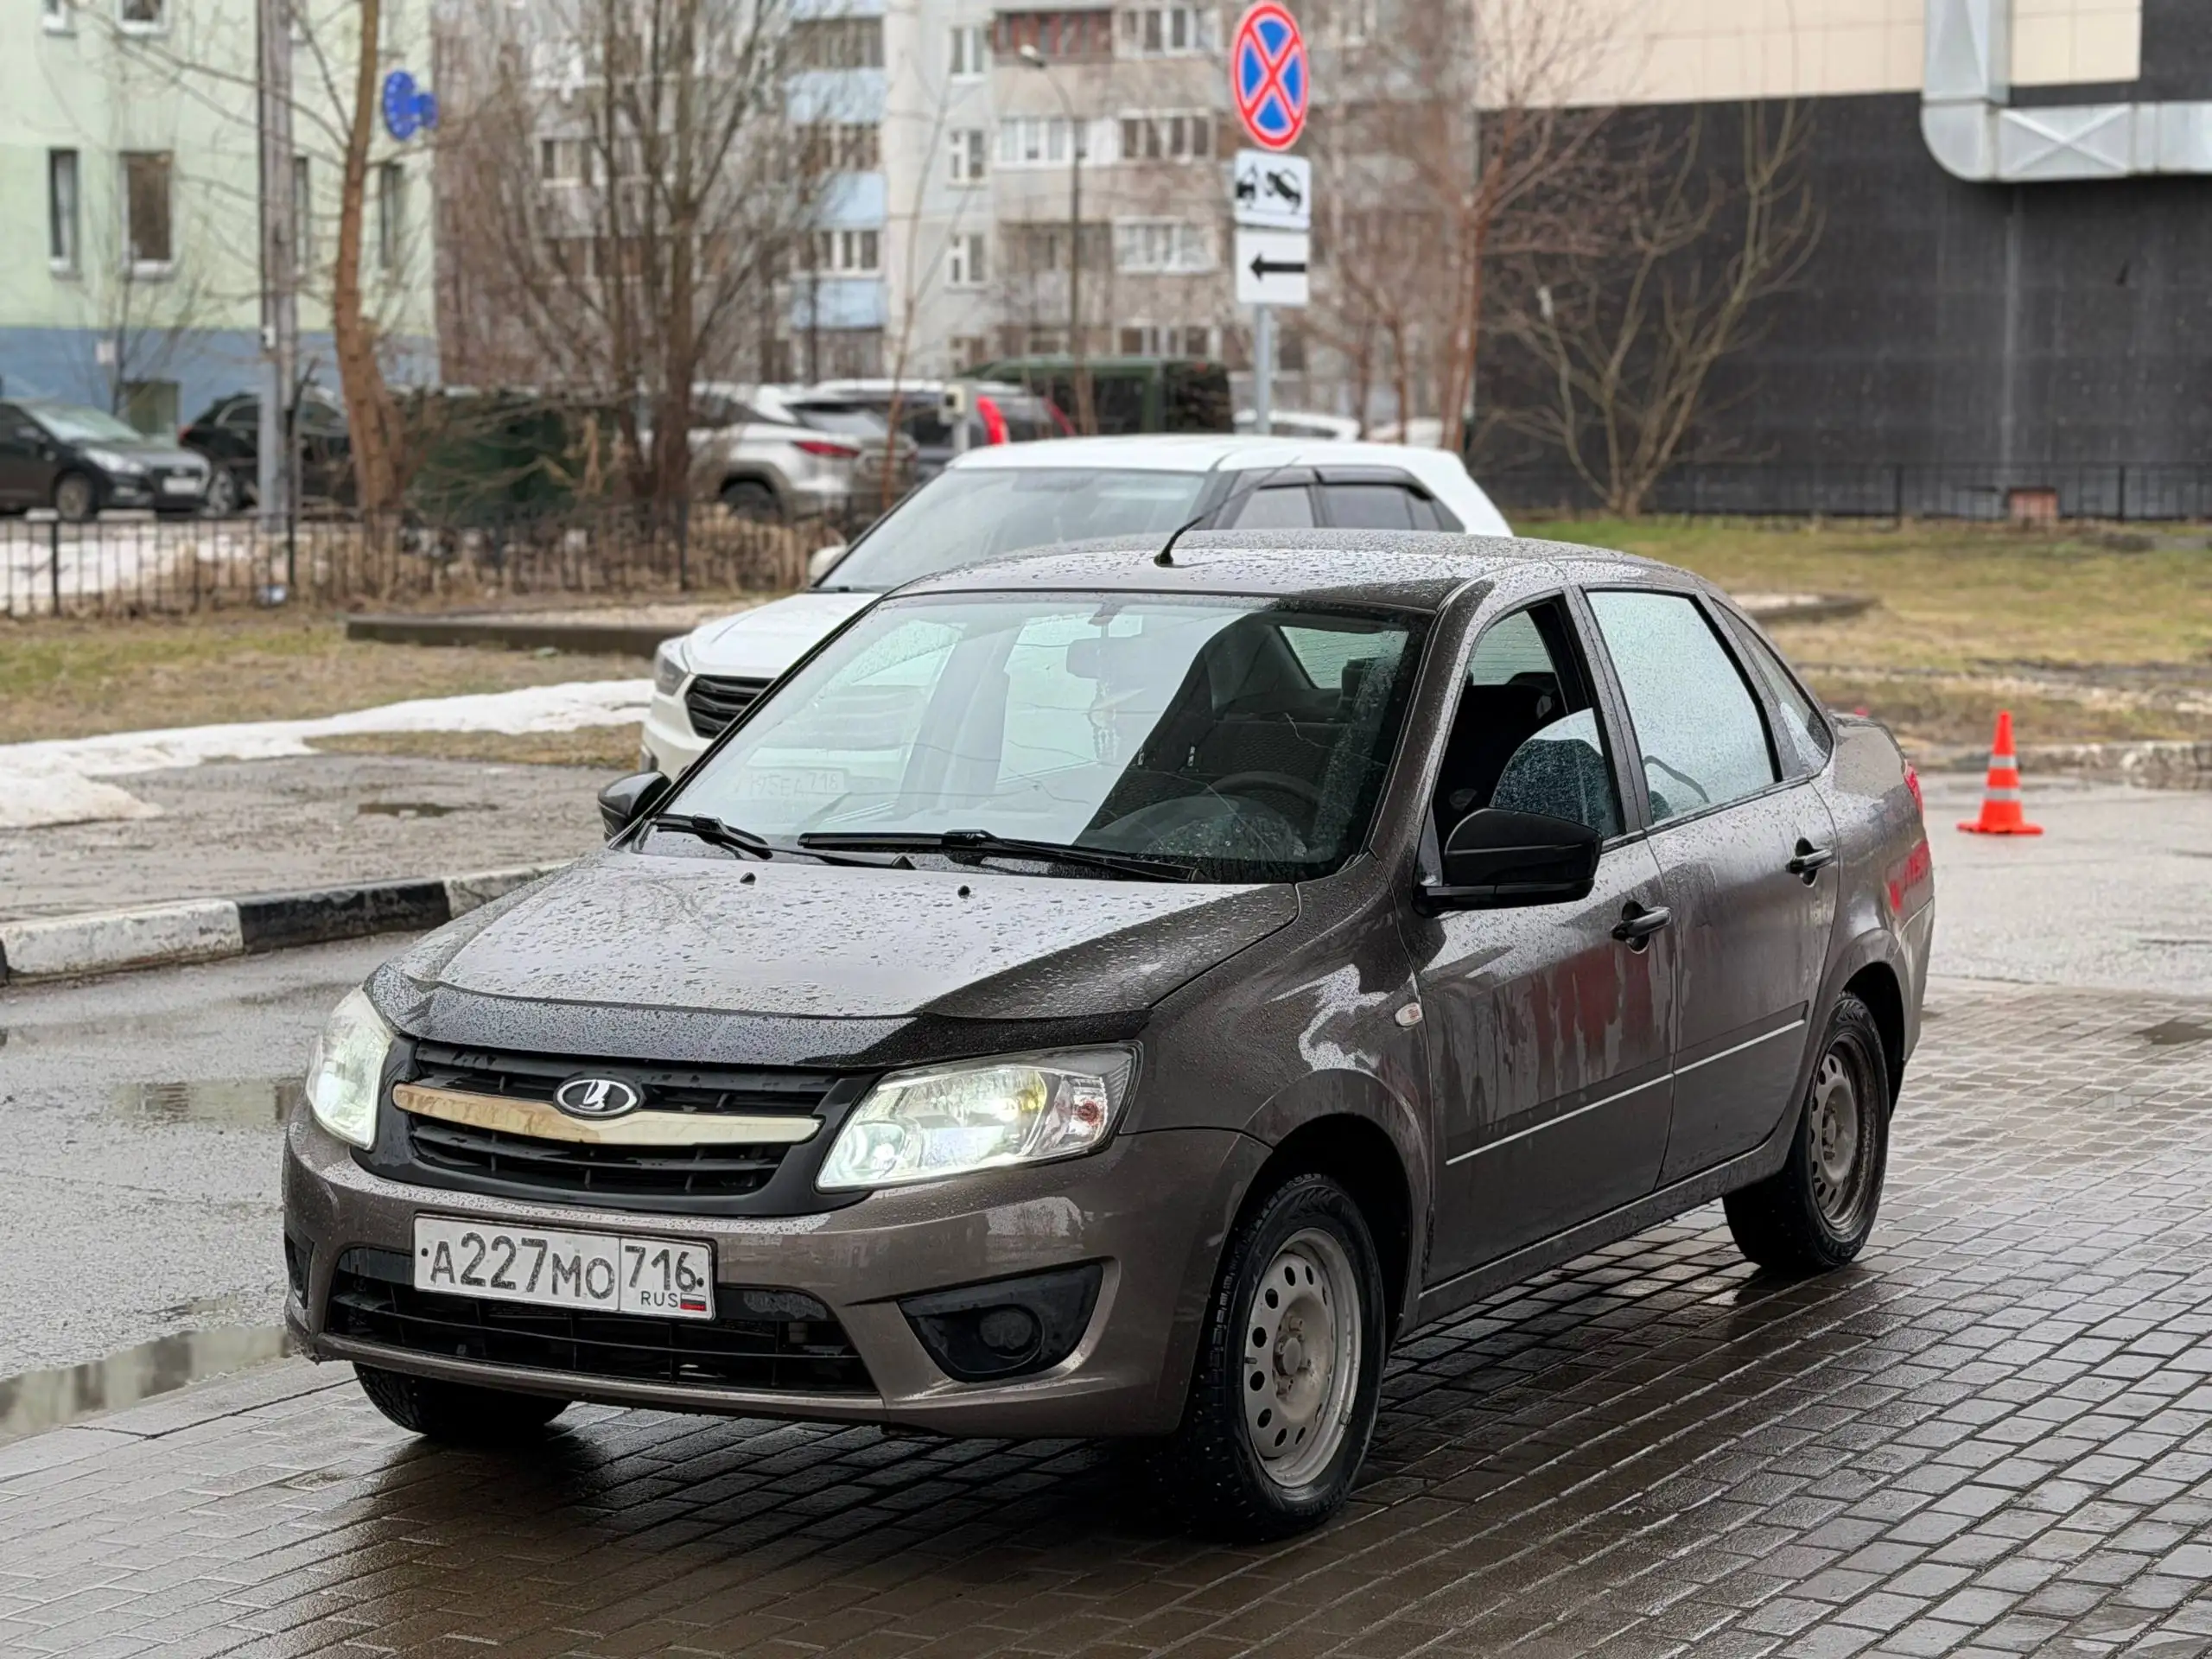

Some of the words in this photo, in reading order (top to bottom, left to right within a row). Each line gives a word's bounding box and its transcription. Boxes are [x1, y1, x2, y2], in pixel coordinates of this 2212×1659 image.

[430, 1231, 615, 1300] А227МО
[625, 1244, 696, 1292] 716
[640, 1290, 678, 1308] RUS
